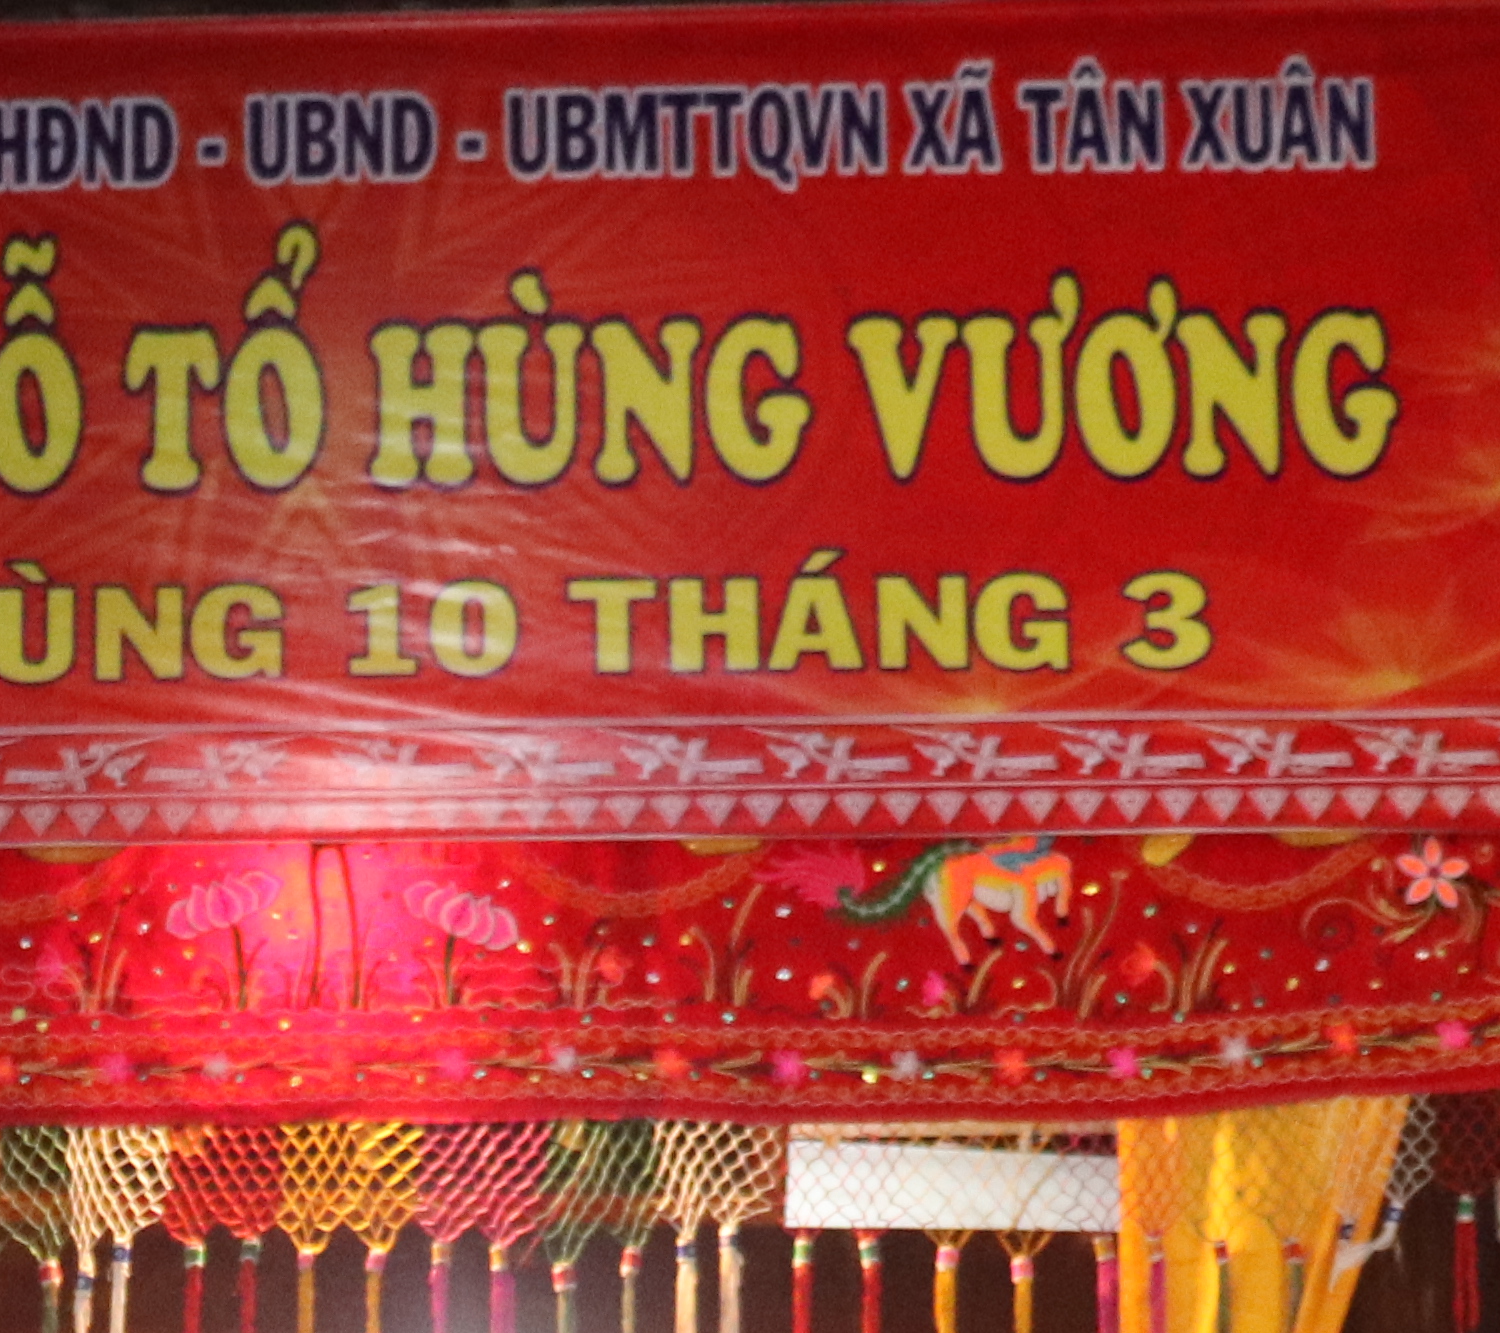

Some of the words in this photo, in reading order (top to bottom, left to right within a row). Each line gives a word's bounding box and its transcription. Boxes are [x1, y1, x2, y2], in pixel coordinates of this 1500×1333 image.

[243, 90, 439, 187] UBND
[503, 82, 888, 192] UBMTTQVN
[902, 58, 1003, 174] XÃ
[1016, 57, 1168, 173] TÂN
[1180, 55, 1378, 172] XUÂN
[122, 221, 328, 492] TỔ
[366, 268, 815, 488] HÙNG
[844, 268, 1402, 484] VƯƠNG
[345, 577, 522, 678] 10
[565, 547, 1073, 674] THÁNG
[1120, 570, 1215, 673] 3
